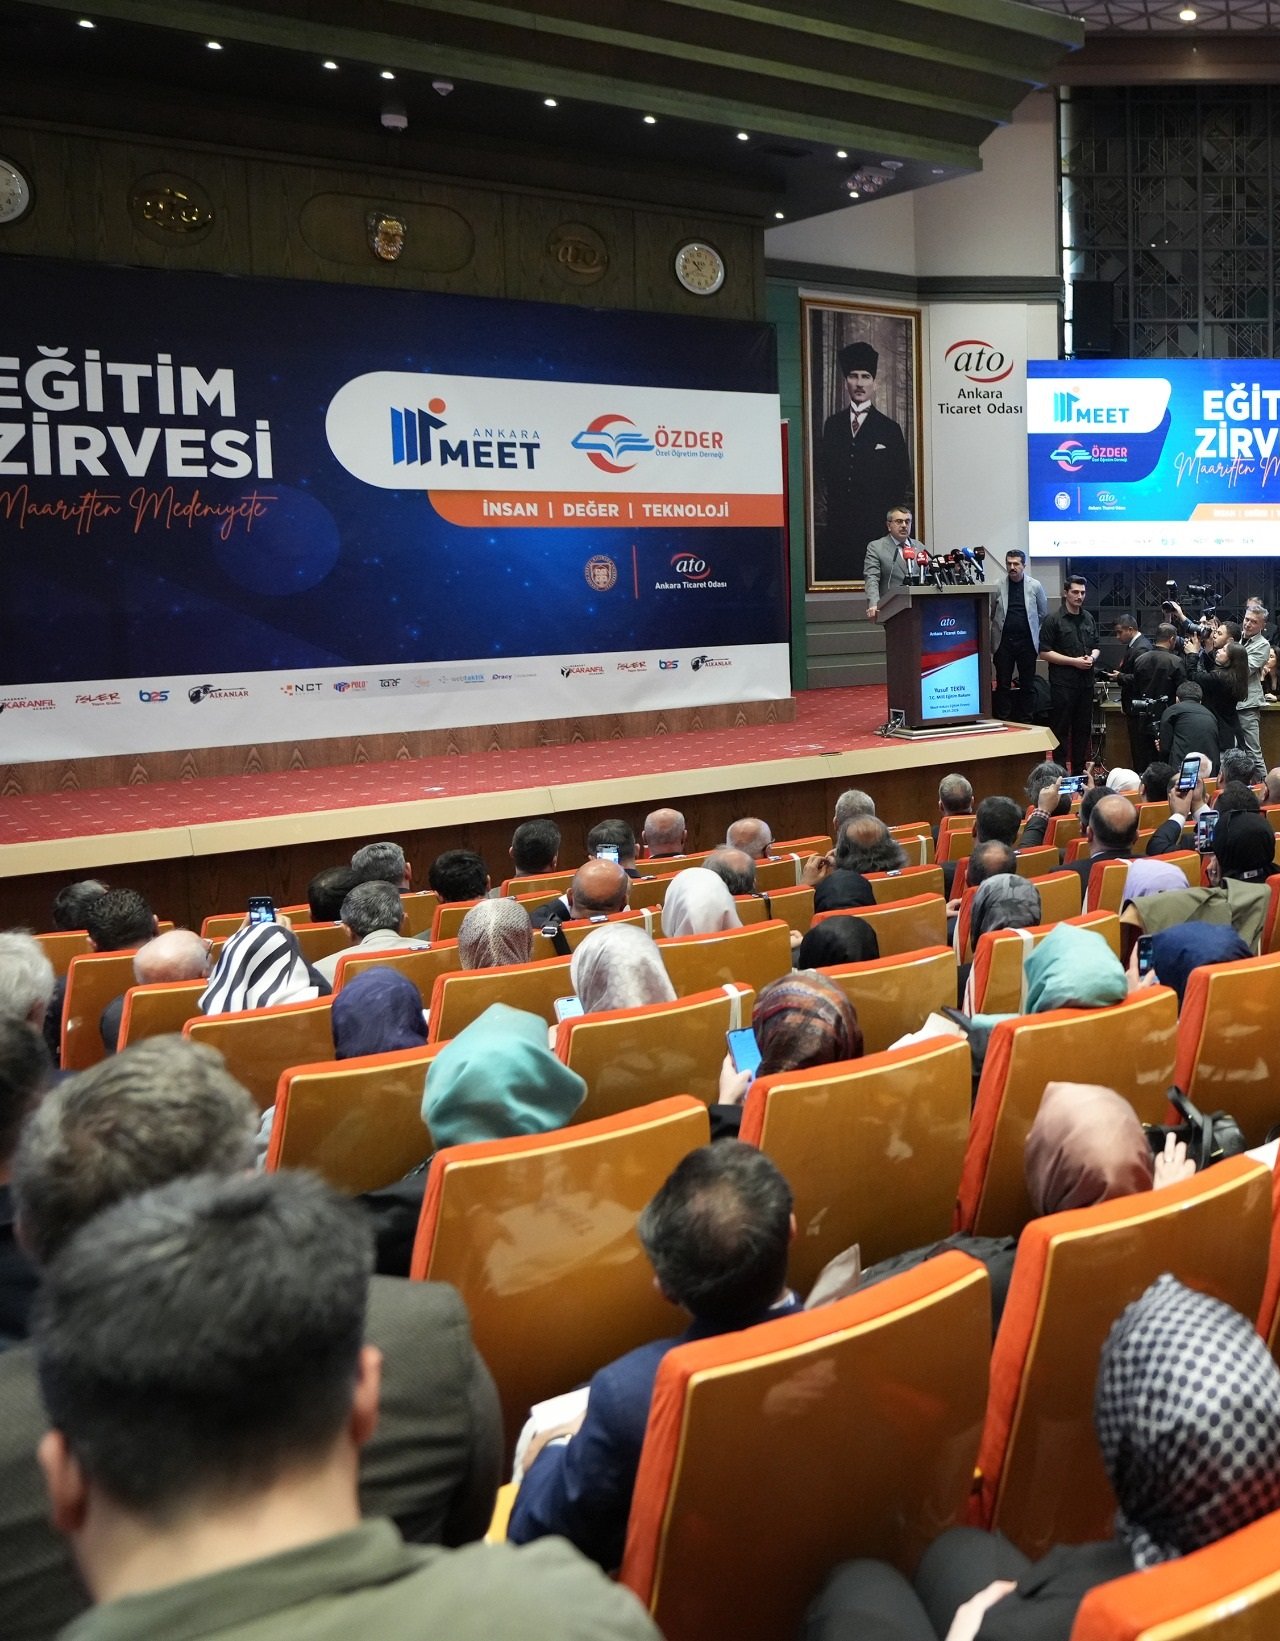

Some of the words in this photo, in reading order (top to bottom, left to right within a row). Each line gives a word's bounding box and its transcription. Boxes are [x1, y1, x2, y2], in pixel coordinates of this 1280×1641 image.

[953, 347, 1005, 372] ato
[957, 388, 1003, 399] Ankara
[938, 403, 981, 414] Ticaret
[987, 402, 1023, 414] Odası
[1076, 408, 1130, 423] MEET
[473, 428, 540, 440] ANKARA
[655, 425, 723, 449] ÖZDER
[0, 411, 274, 479] ZİRVESİ
[1091, 444, 1128, 458] ÖZDER
[440, 439, 541, 470] MEET
[671, 450, 699, 459] Öğretim
[699, 451, 724, 459] Derneği
[1174, 452, 1255, 488] Maariften
[129, 486, 278, 541] Medeniyete
[483, 499, 539, 516] İNSAN
[563, 500, 619, 517] DEĞER
[642, 501, 729, 517] TEKNOLOJİ
[675, 557, 706, 573] ato
[655, 582, 681, 590] Ankara
[682, 581, 707, 589] Ticaret
[707, 580, 727, 588] Odası
[940, 618, 956, 627] ato
[209, 690, 249, 699] ALKANLAR
[295, 683, 323, 692] NCT
